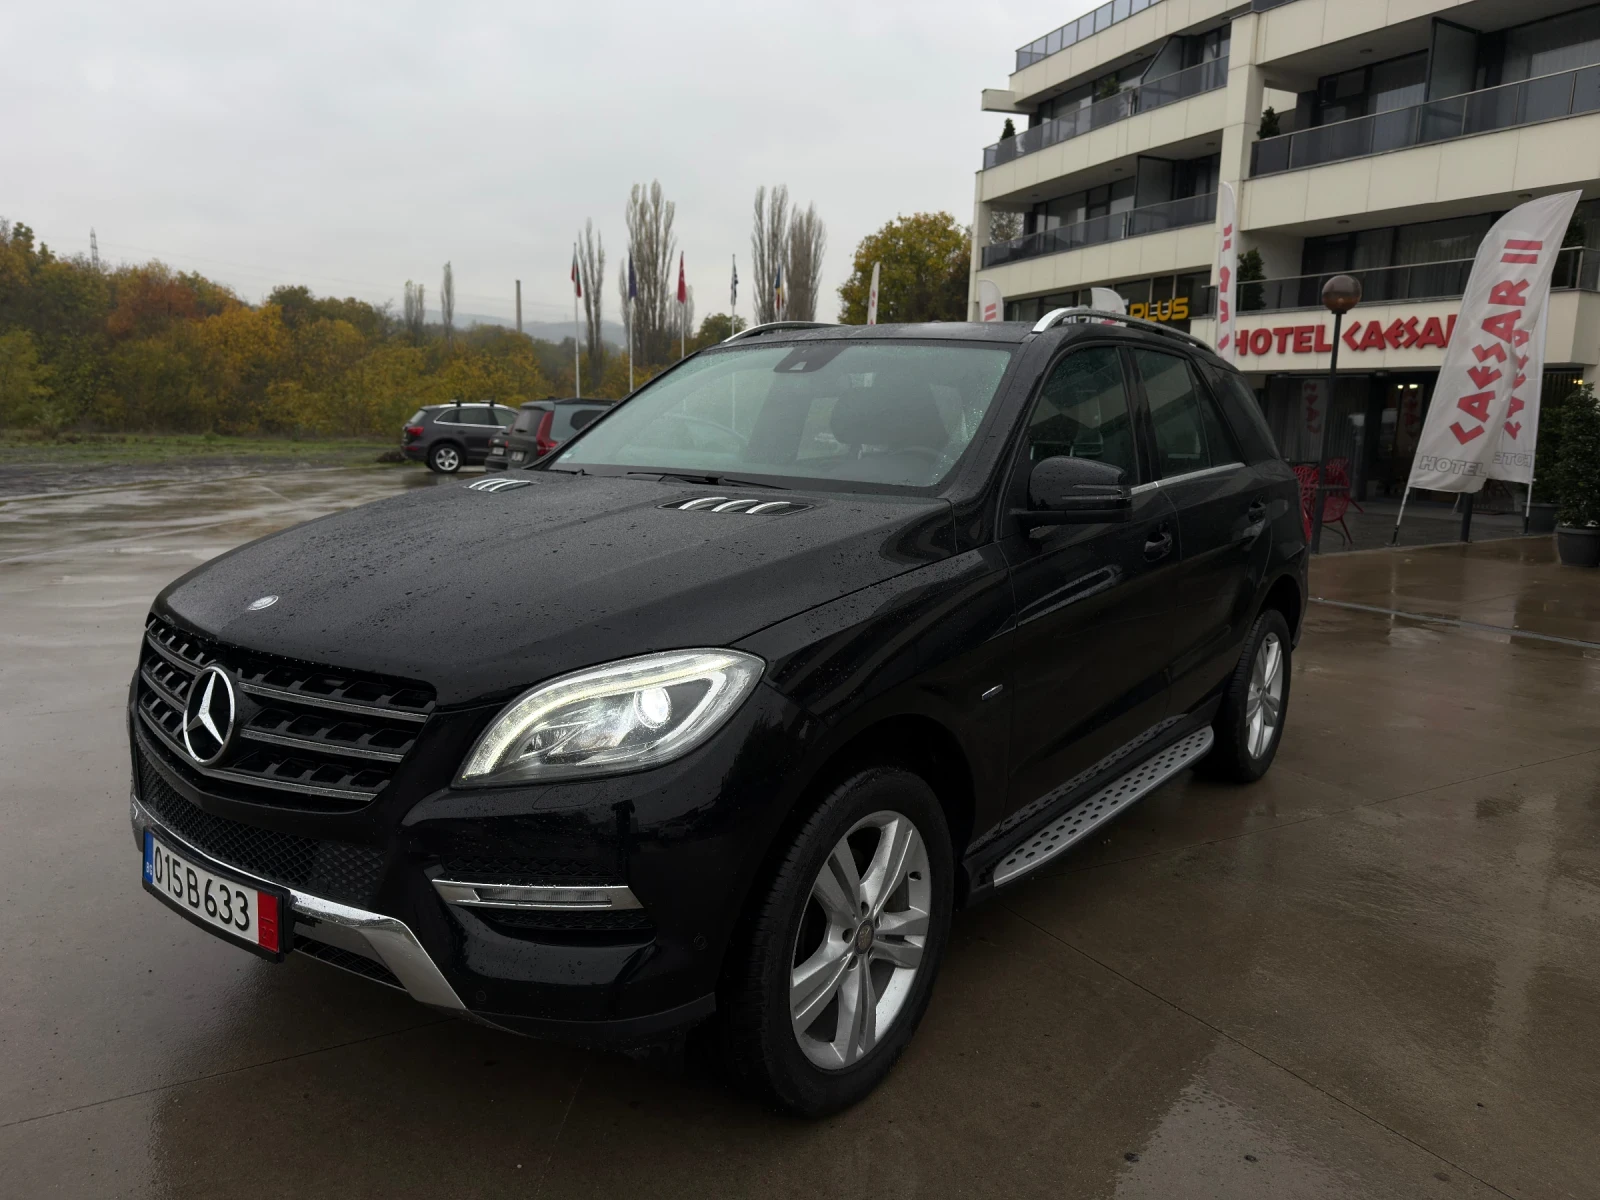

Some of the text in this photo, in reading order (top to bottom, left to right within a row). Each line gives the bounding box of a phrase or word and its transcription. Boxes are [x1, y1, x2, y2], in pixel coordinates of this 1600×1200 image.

[1129, 296, 1190, 323] PLUS
[1234, 313, 1458, 356] HOTEL CAESA
[1449, 238, 1544, 446] CAESAR II
[1418, 454, 1487, 478] HOTEL
[154, 845, 250, 932] 015B633
